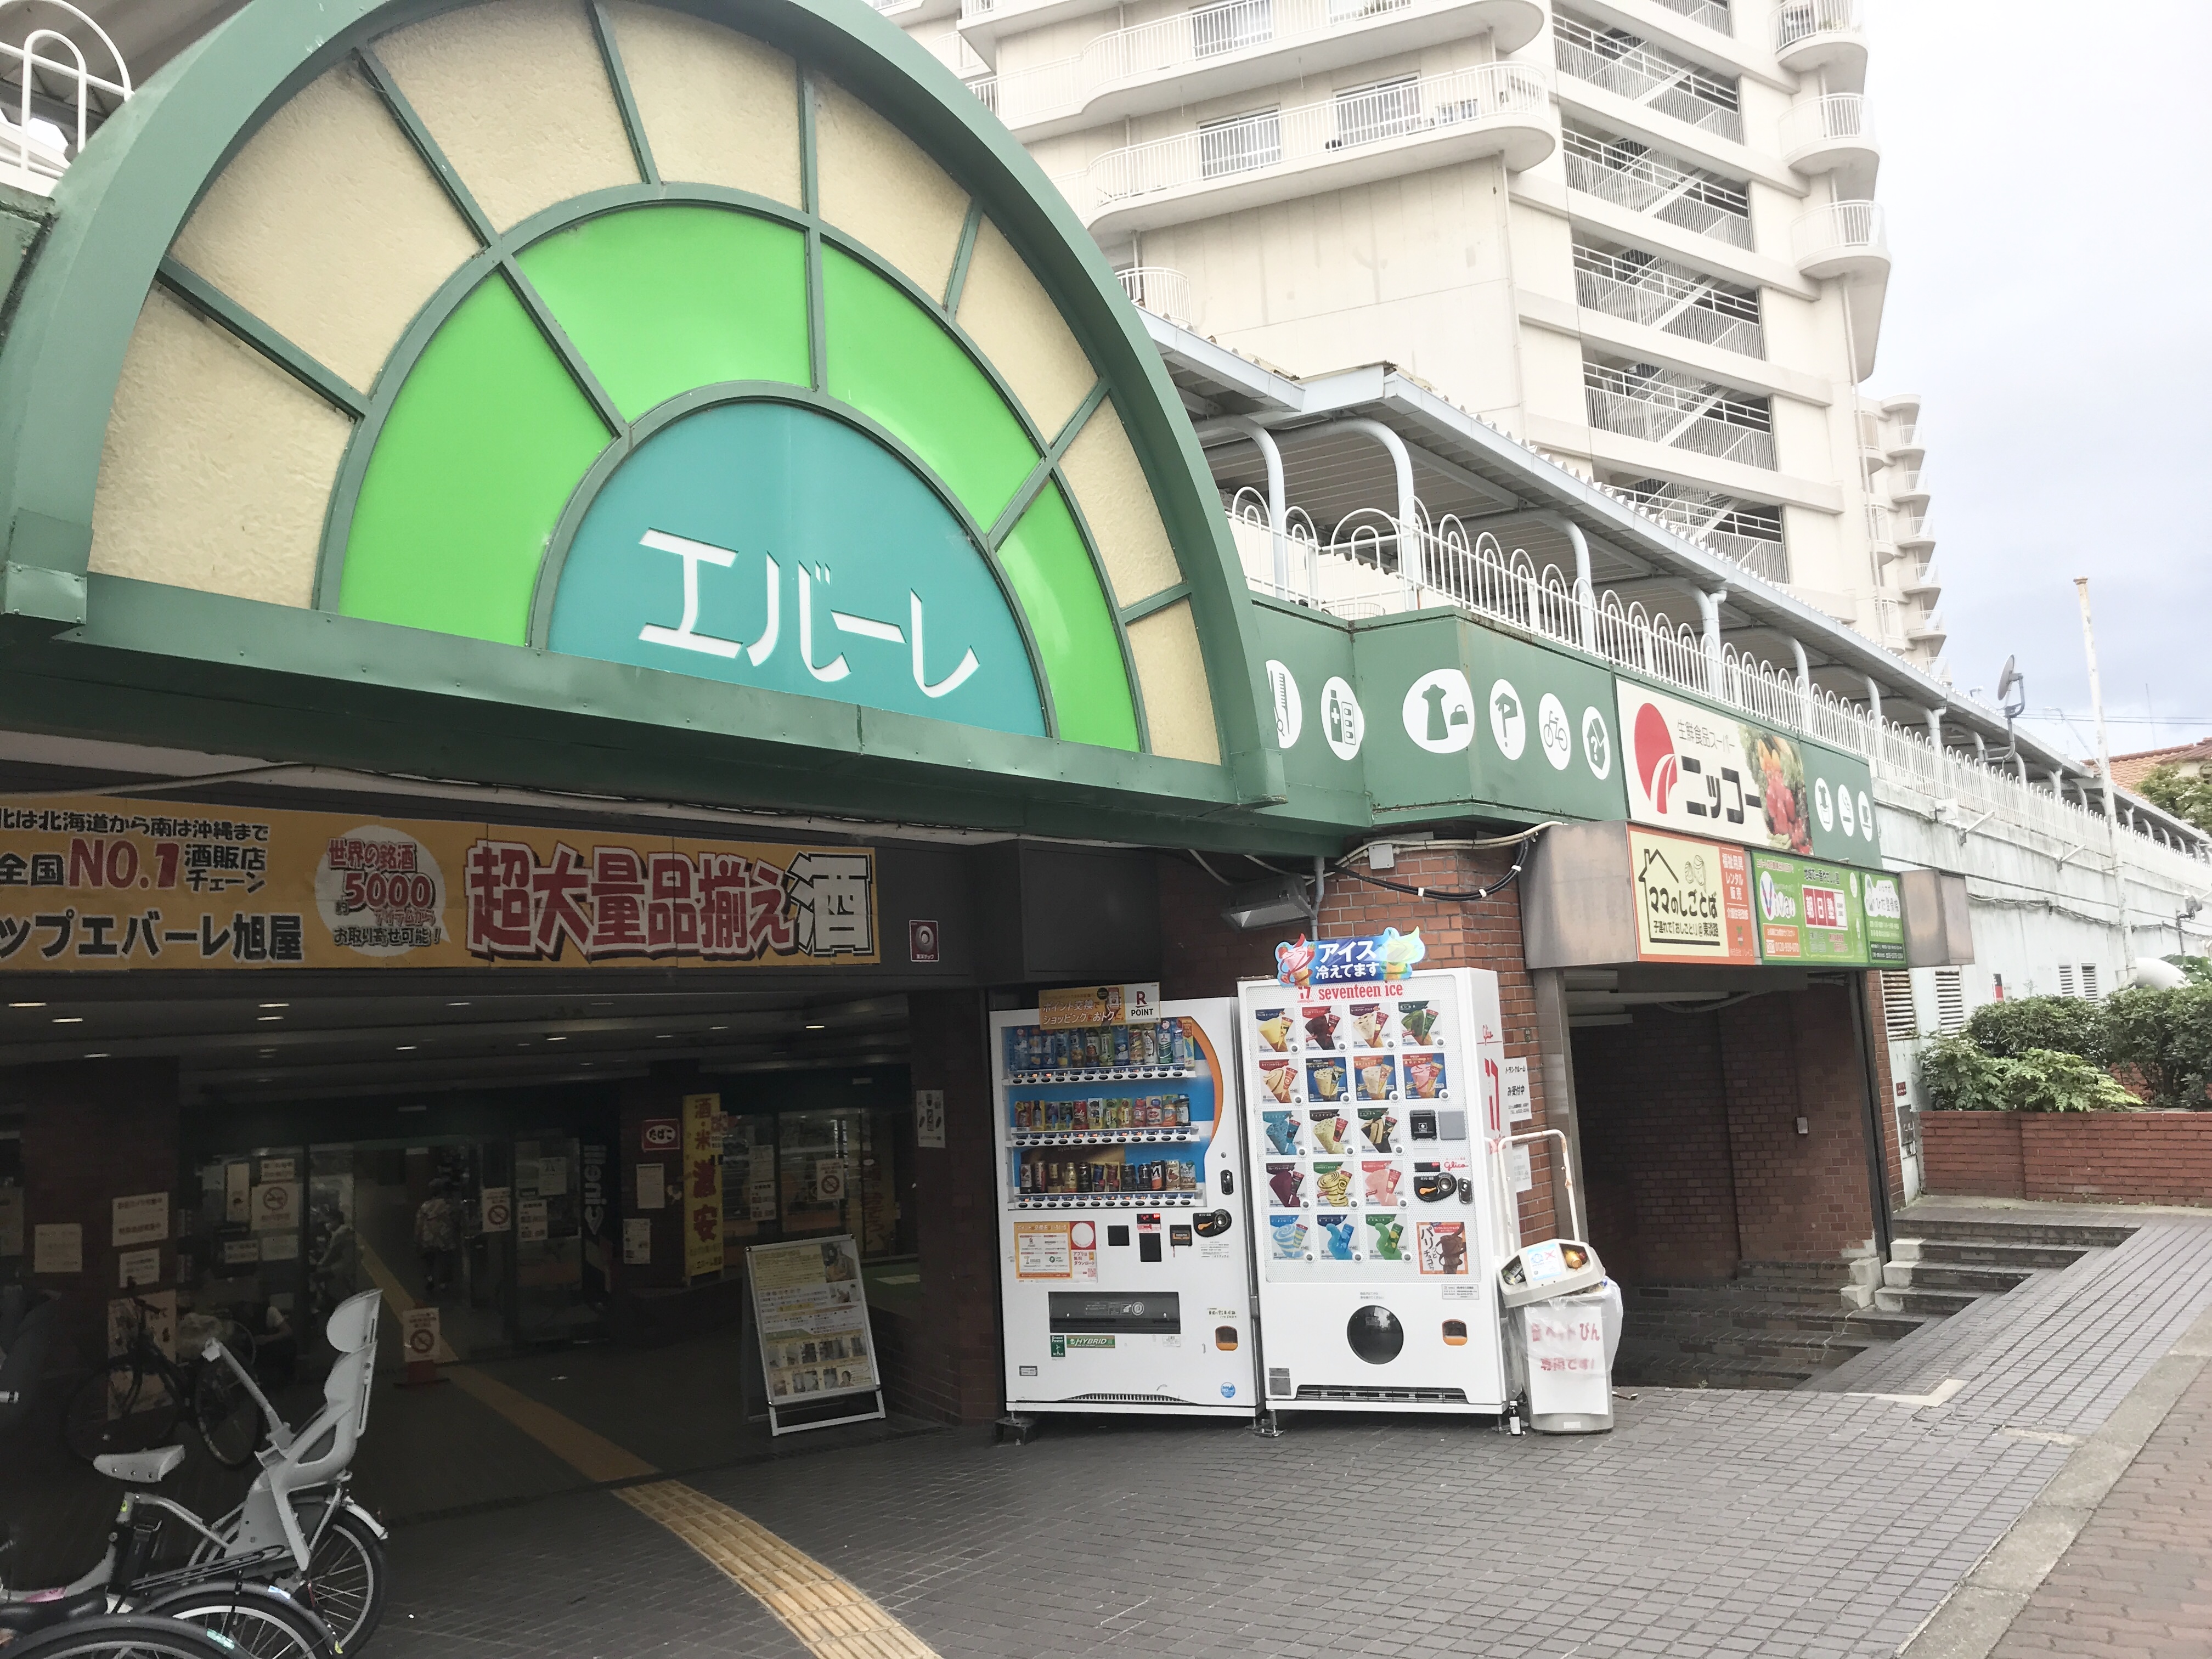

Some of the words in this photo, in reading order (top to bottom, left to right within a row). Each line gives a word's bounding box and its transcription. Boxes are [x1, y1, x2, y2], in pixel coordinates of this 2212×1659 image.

[638, 527, 980, 698] エバーレ
[1677, 719, 1735, 753] 生鮮食品スーパー
[1681, 755, 1762, 825] ニッコー
[0, 808, 268, 841] 北は北海道から南は沖縄まで
[69, 838, 179, 888] NO.1
[184, 843, 266, 871] 酒販店
[329, 839, 416, 872] 世界の銘酒
[186, 869, 266, 894] チェーン
[344, 871, 435, 910] 5000
[1725, 872, 1743, 885] レンタル
[466, 840, 798, 956] 超大量品揃え
[788, 851, 872, 956] 酒
[1649, 886, 1718, 919] ママのしごとば
[1730, 887, 1742, 900] 販売
[1318, 940, 1377, 963] アイス
[1315, 961, 1380, 980] 冷えてます
[1318, 984, 1381, 1001] seventeen
[1384, 980, 1403, 997] ice
[1131, 1008, 1153, 1017] POINT
[648, 1128, 672, 1141] たばこ
[1444, 1161, 1469, 1171] Glico
[1074, 1338, 1107, 1347] HYBRID
